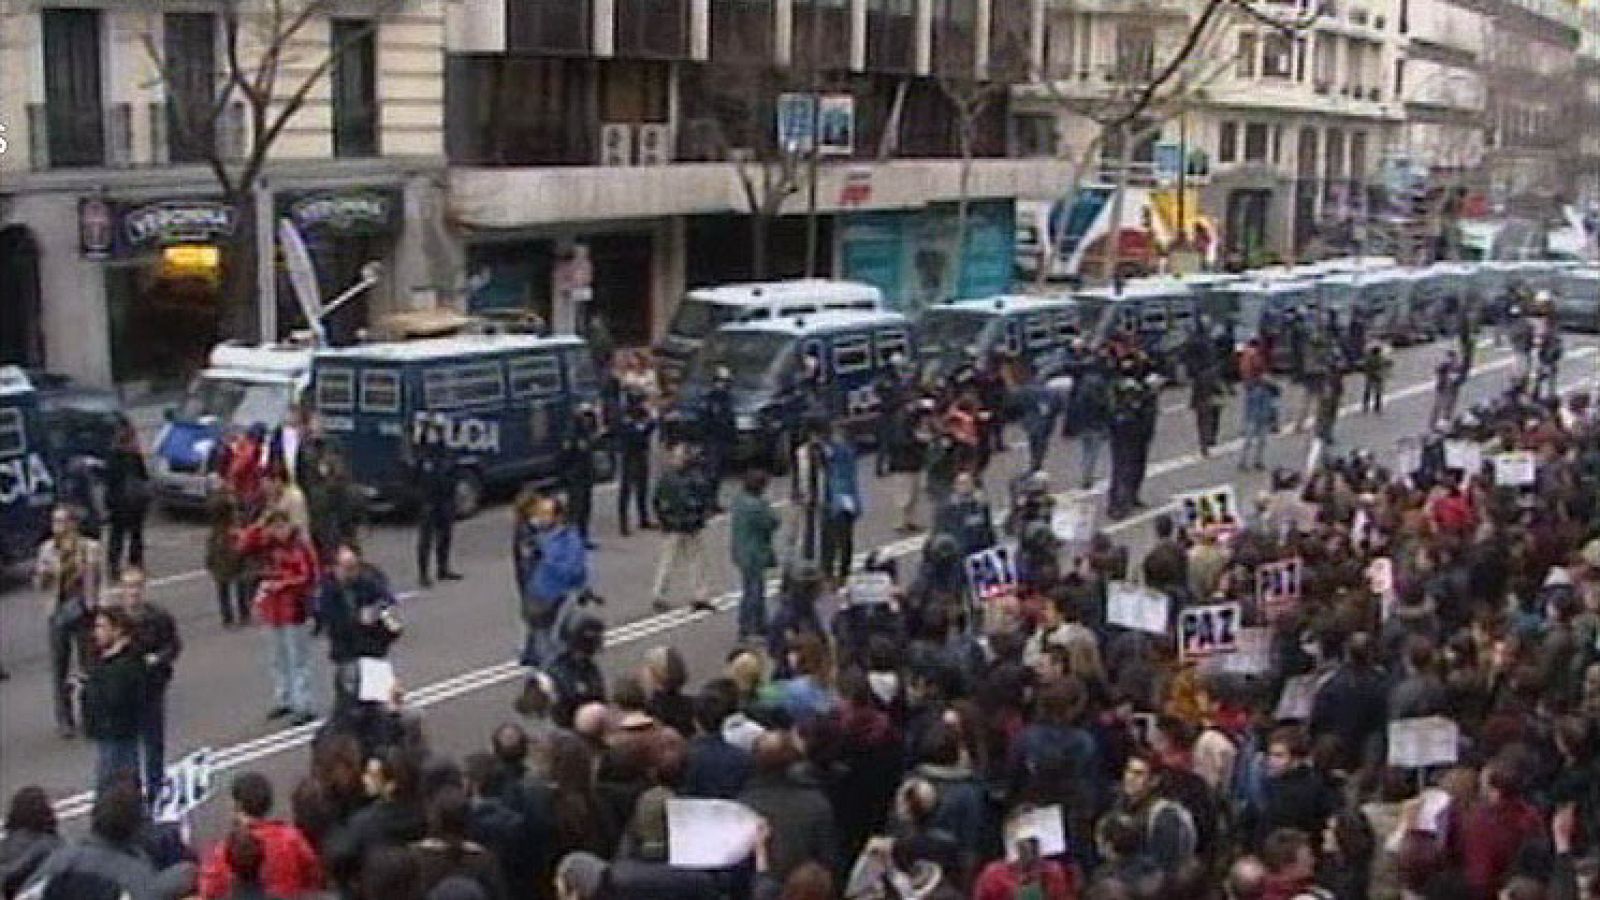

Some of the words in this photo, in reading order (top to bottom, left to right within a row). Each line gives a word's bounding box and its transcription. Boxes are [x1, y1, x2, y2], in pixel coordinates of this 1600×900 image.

[1181, 492, 1236, 531] PAZ
[970, 549, 1013, 592] PAZ
[1182, 608, 1237, 652] PAZ
